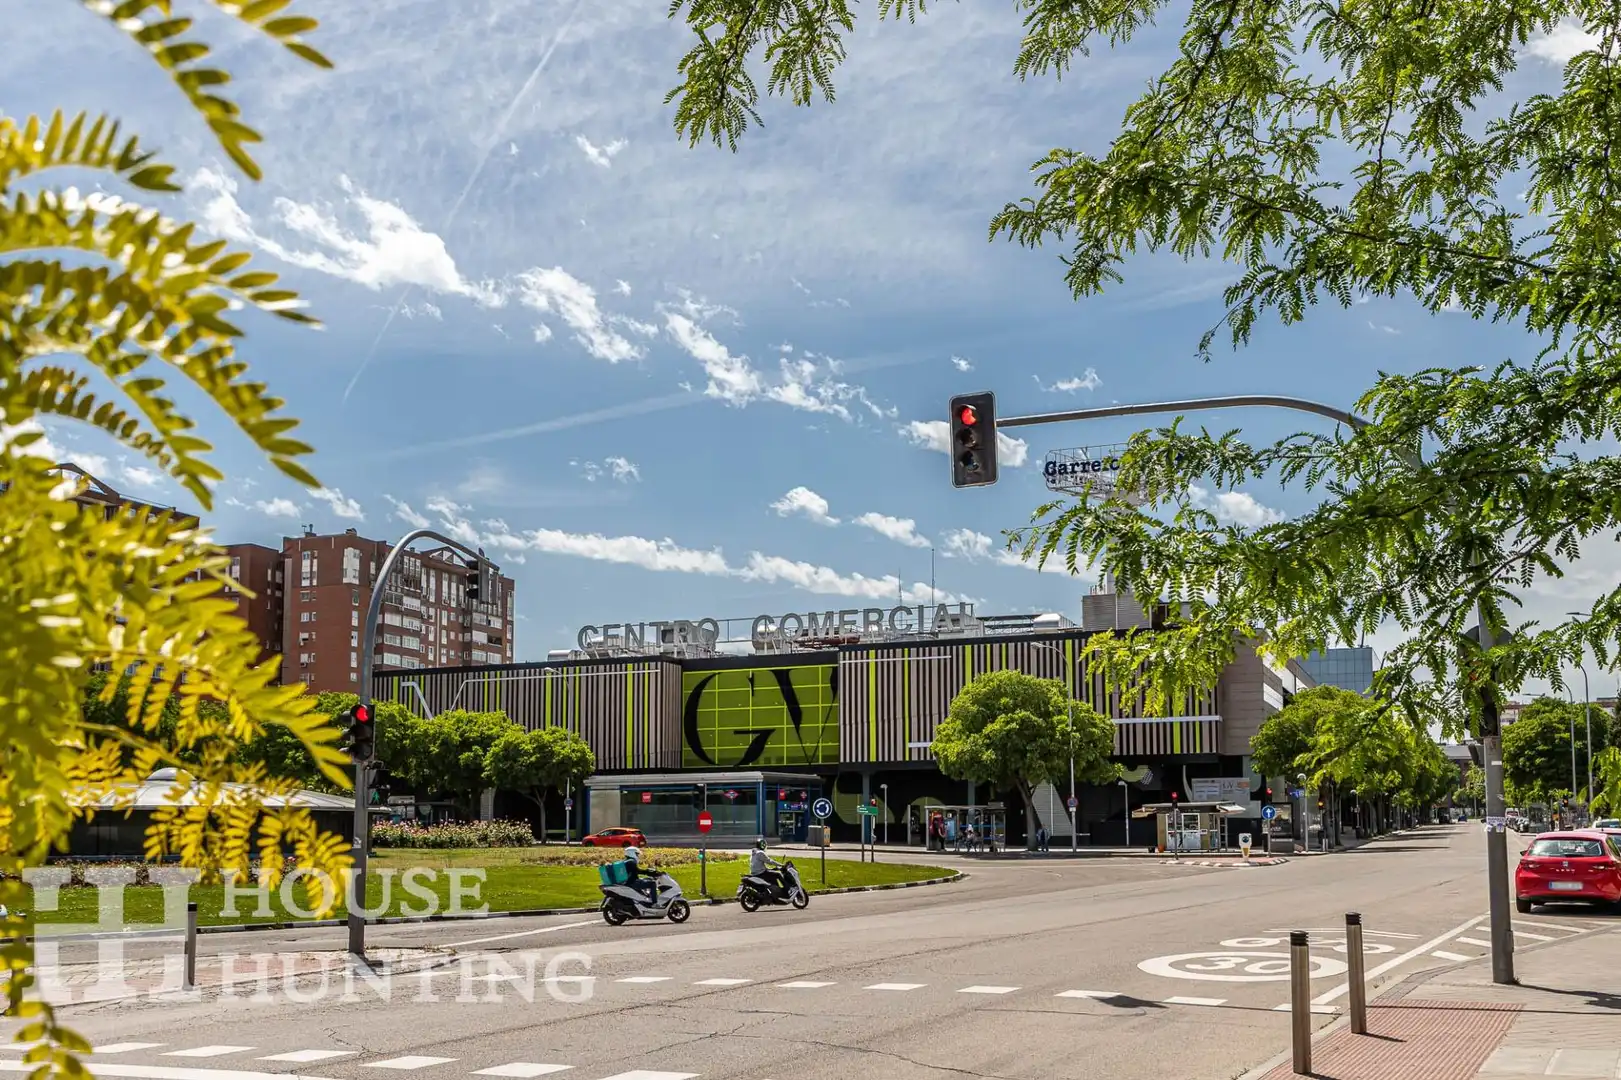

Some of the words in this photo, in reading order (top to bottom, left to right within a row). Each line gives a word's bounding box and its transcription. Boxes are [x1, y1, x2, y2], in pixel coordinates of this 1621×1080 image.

[577, 617, 720, 651] CENTRO
[752, 602, 979, 641] COMERCIAL
[684, 666, 839, 767] GV
[1185, 956, 1293, 973] 30
